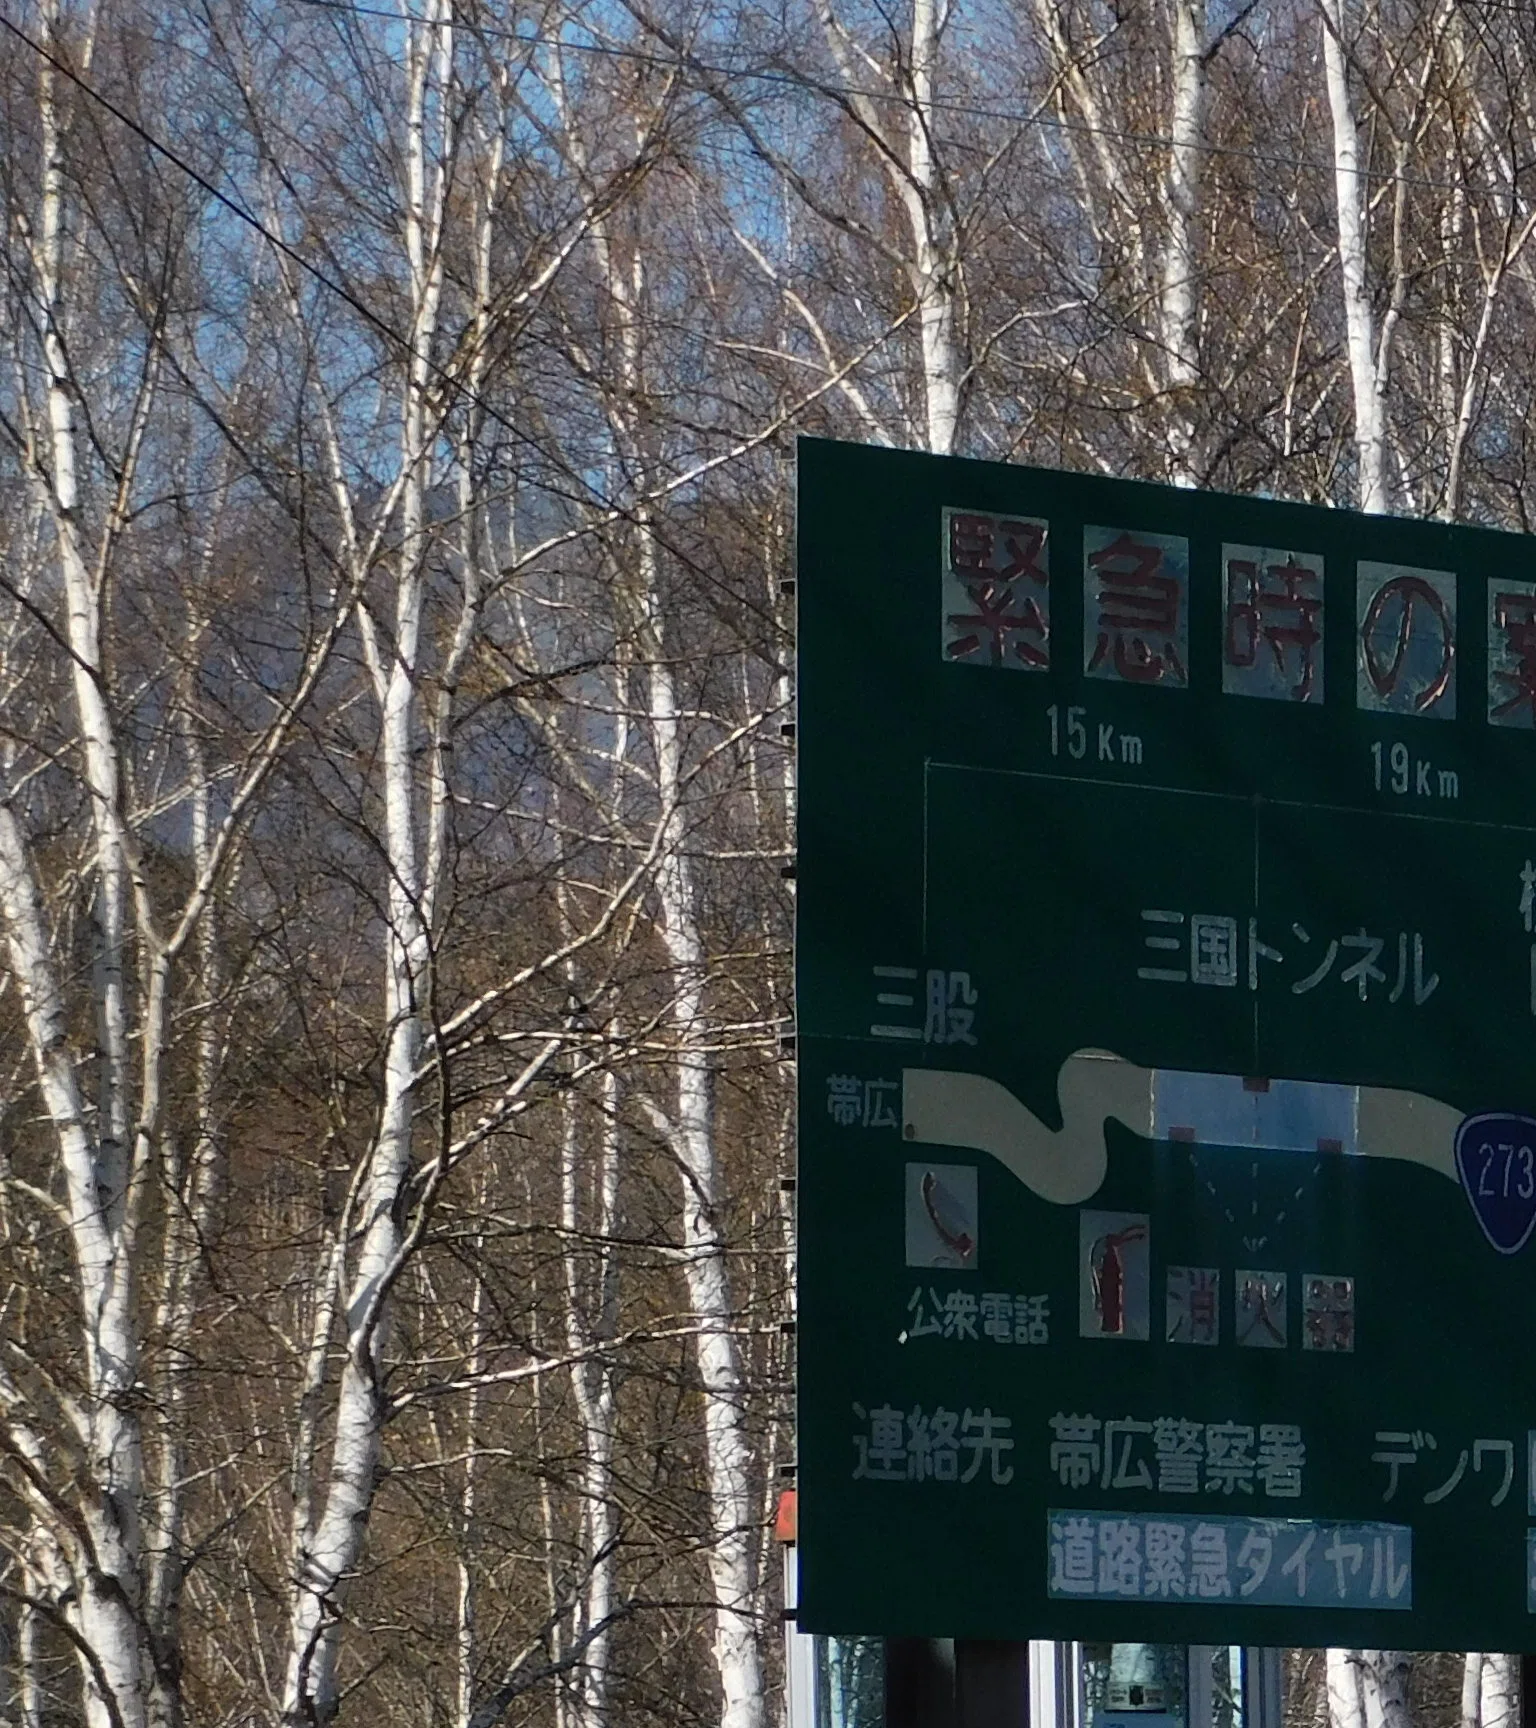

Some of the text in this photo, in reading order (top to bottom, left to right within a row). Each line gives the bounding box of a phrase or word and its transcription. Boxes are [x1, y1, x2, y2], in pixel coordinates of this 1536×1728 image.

[1137, 909, 1440, 1006] 三国トンネル
[869, 965, 979, 1046] 三股
[825, 1073, 899, 1129] 帯広
[1478, 1142, 1535, 1199] 273
[905, 1286, 1050, 1345] 公衆電話
[1166, 1268, 1353, 1348] 消火器
[851, 1401, 1015, 1485] 連絡先
[1048, 1411, 1306, 1498] 帯広警察署
[1371, 1428, 1515, 1507] デンワ
[1050, 1518, 1410, 1600] 道路緊急ダイヤル
